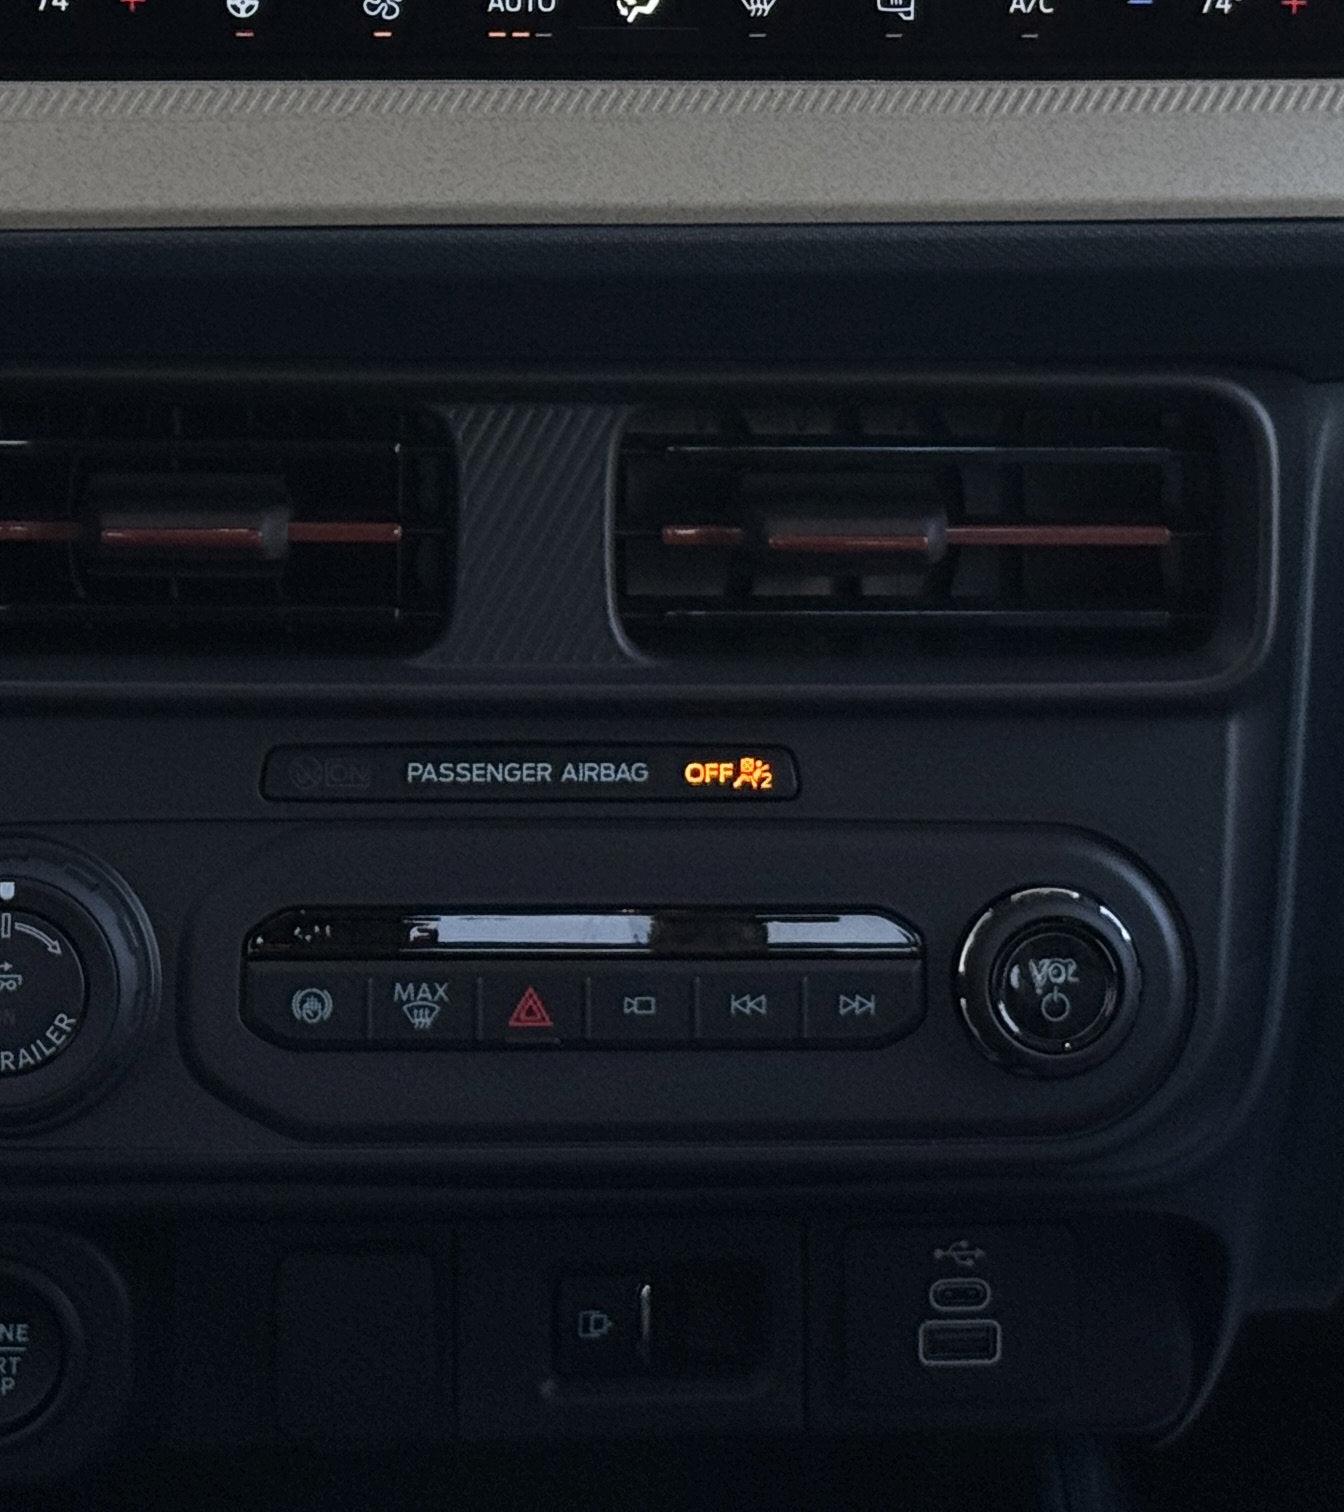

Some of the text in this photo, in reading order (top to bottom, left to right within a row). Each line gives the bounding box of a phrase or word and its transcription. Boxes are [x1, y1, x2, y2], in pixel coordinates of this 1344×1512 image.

[407, 762, 649, 783] PASSENGER AIRBAG
[684, 762, 734, 784] OFF
[393, 982, 449, 1002] MAX
